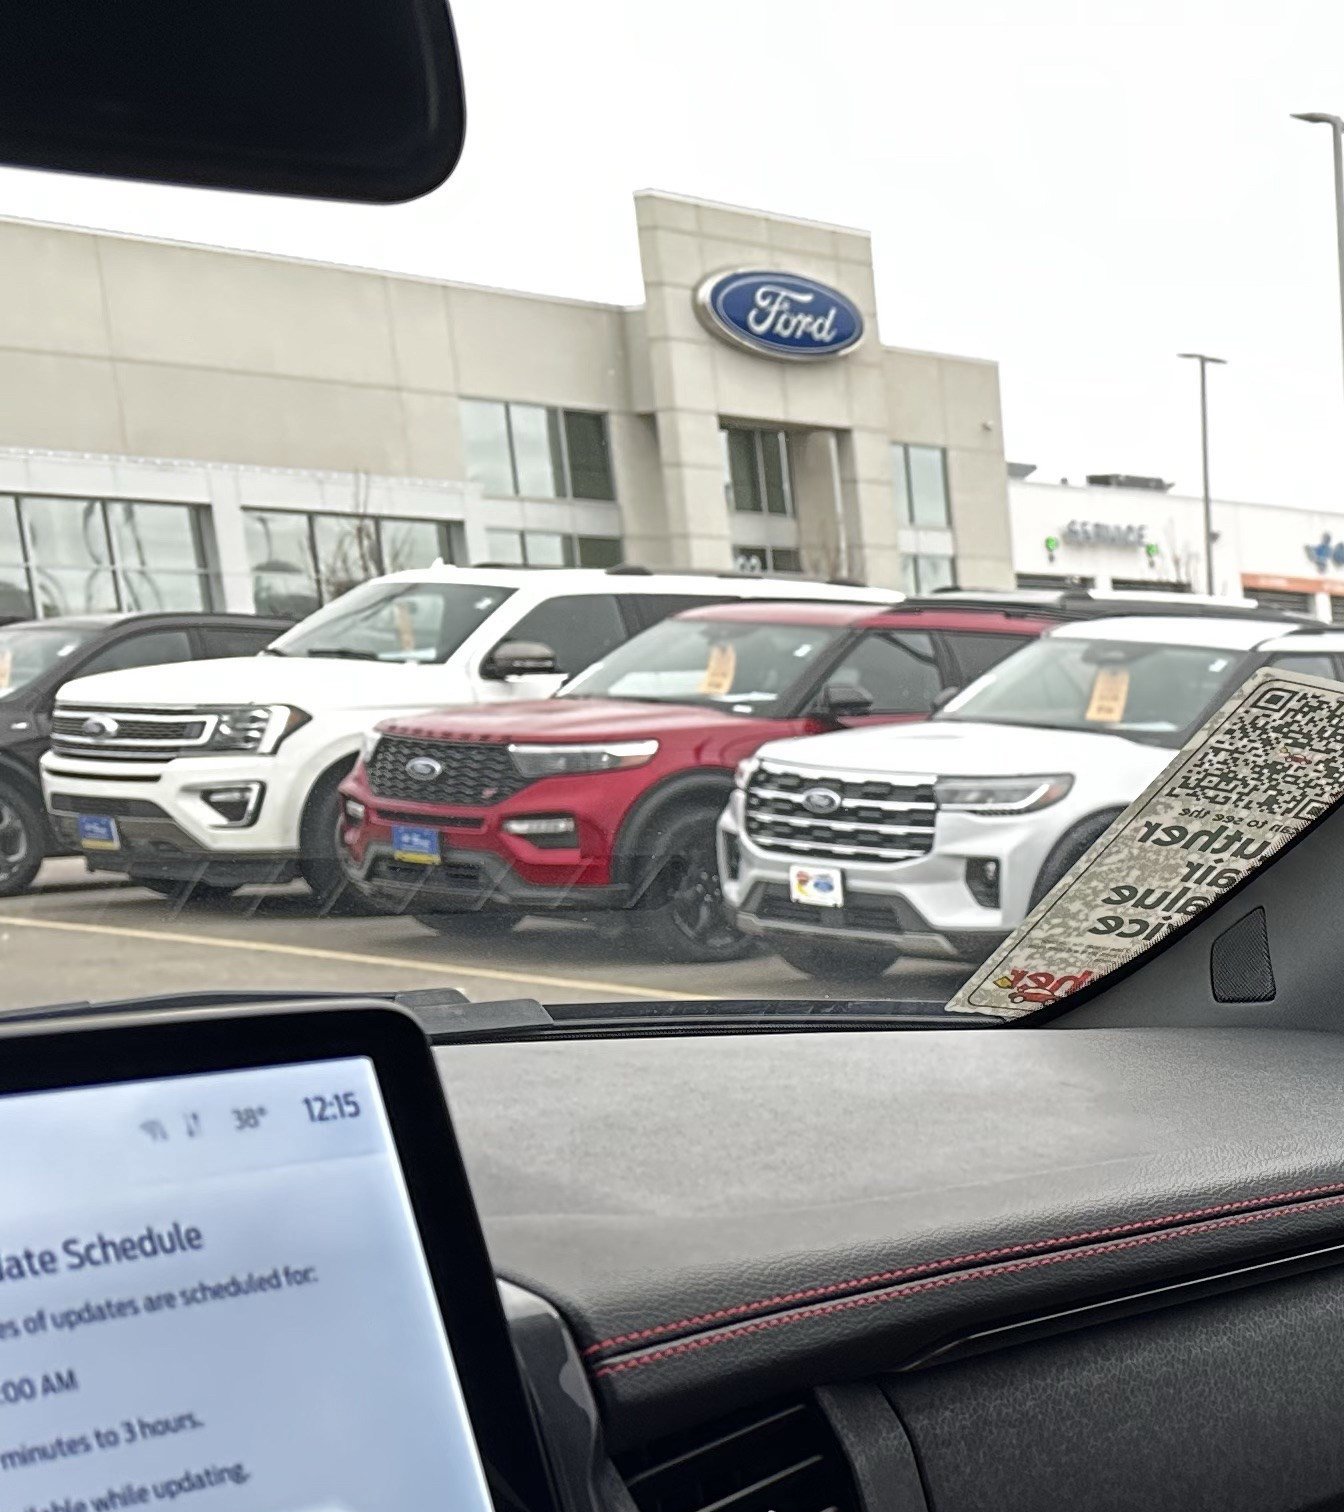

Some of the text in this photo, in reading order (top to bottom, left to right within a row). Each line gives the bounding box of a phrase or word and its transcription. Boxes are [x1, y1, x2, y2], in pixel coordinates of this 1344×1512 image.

[747, 284, 839, 344] Ford
[230, 1092, 361, 1131] 38° 12:15
[61, 1222, 204, 1272] Schedule
[23, 1308, 49, 1335] of
[50, 1296, 141, 1332] updates
[143, 1289, 178, 1314] are
[179, 1267, 284, 1308] scheduled
[282, 1265, 319, 1289] for:
[40, 1368, 79, 1398] AM
[1, 1411, 204, 1471] minutes to 3 hours.
[149, 1461, 251, 1501] updating.
